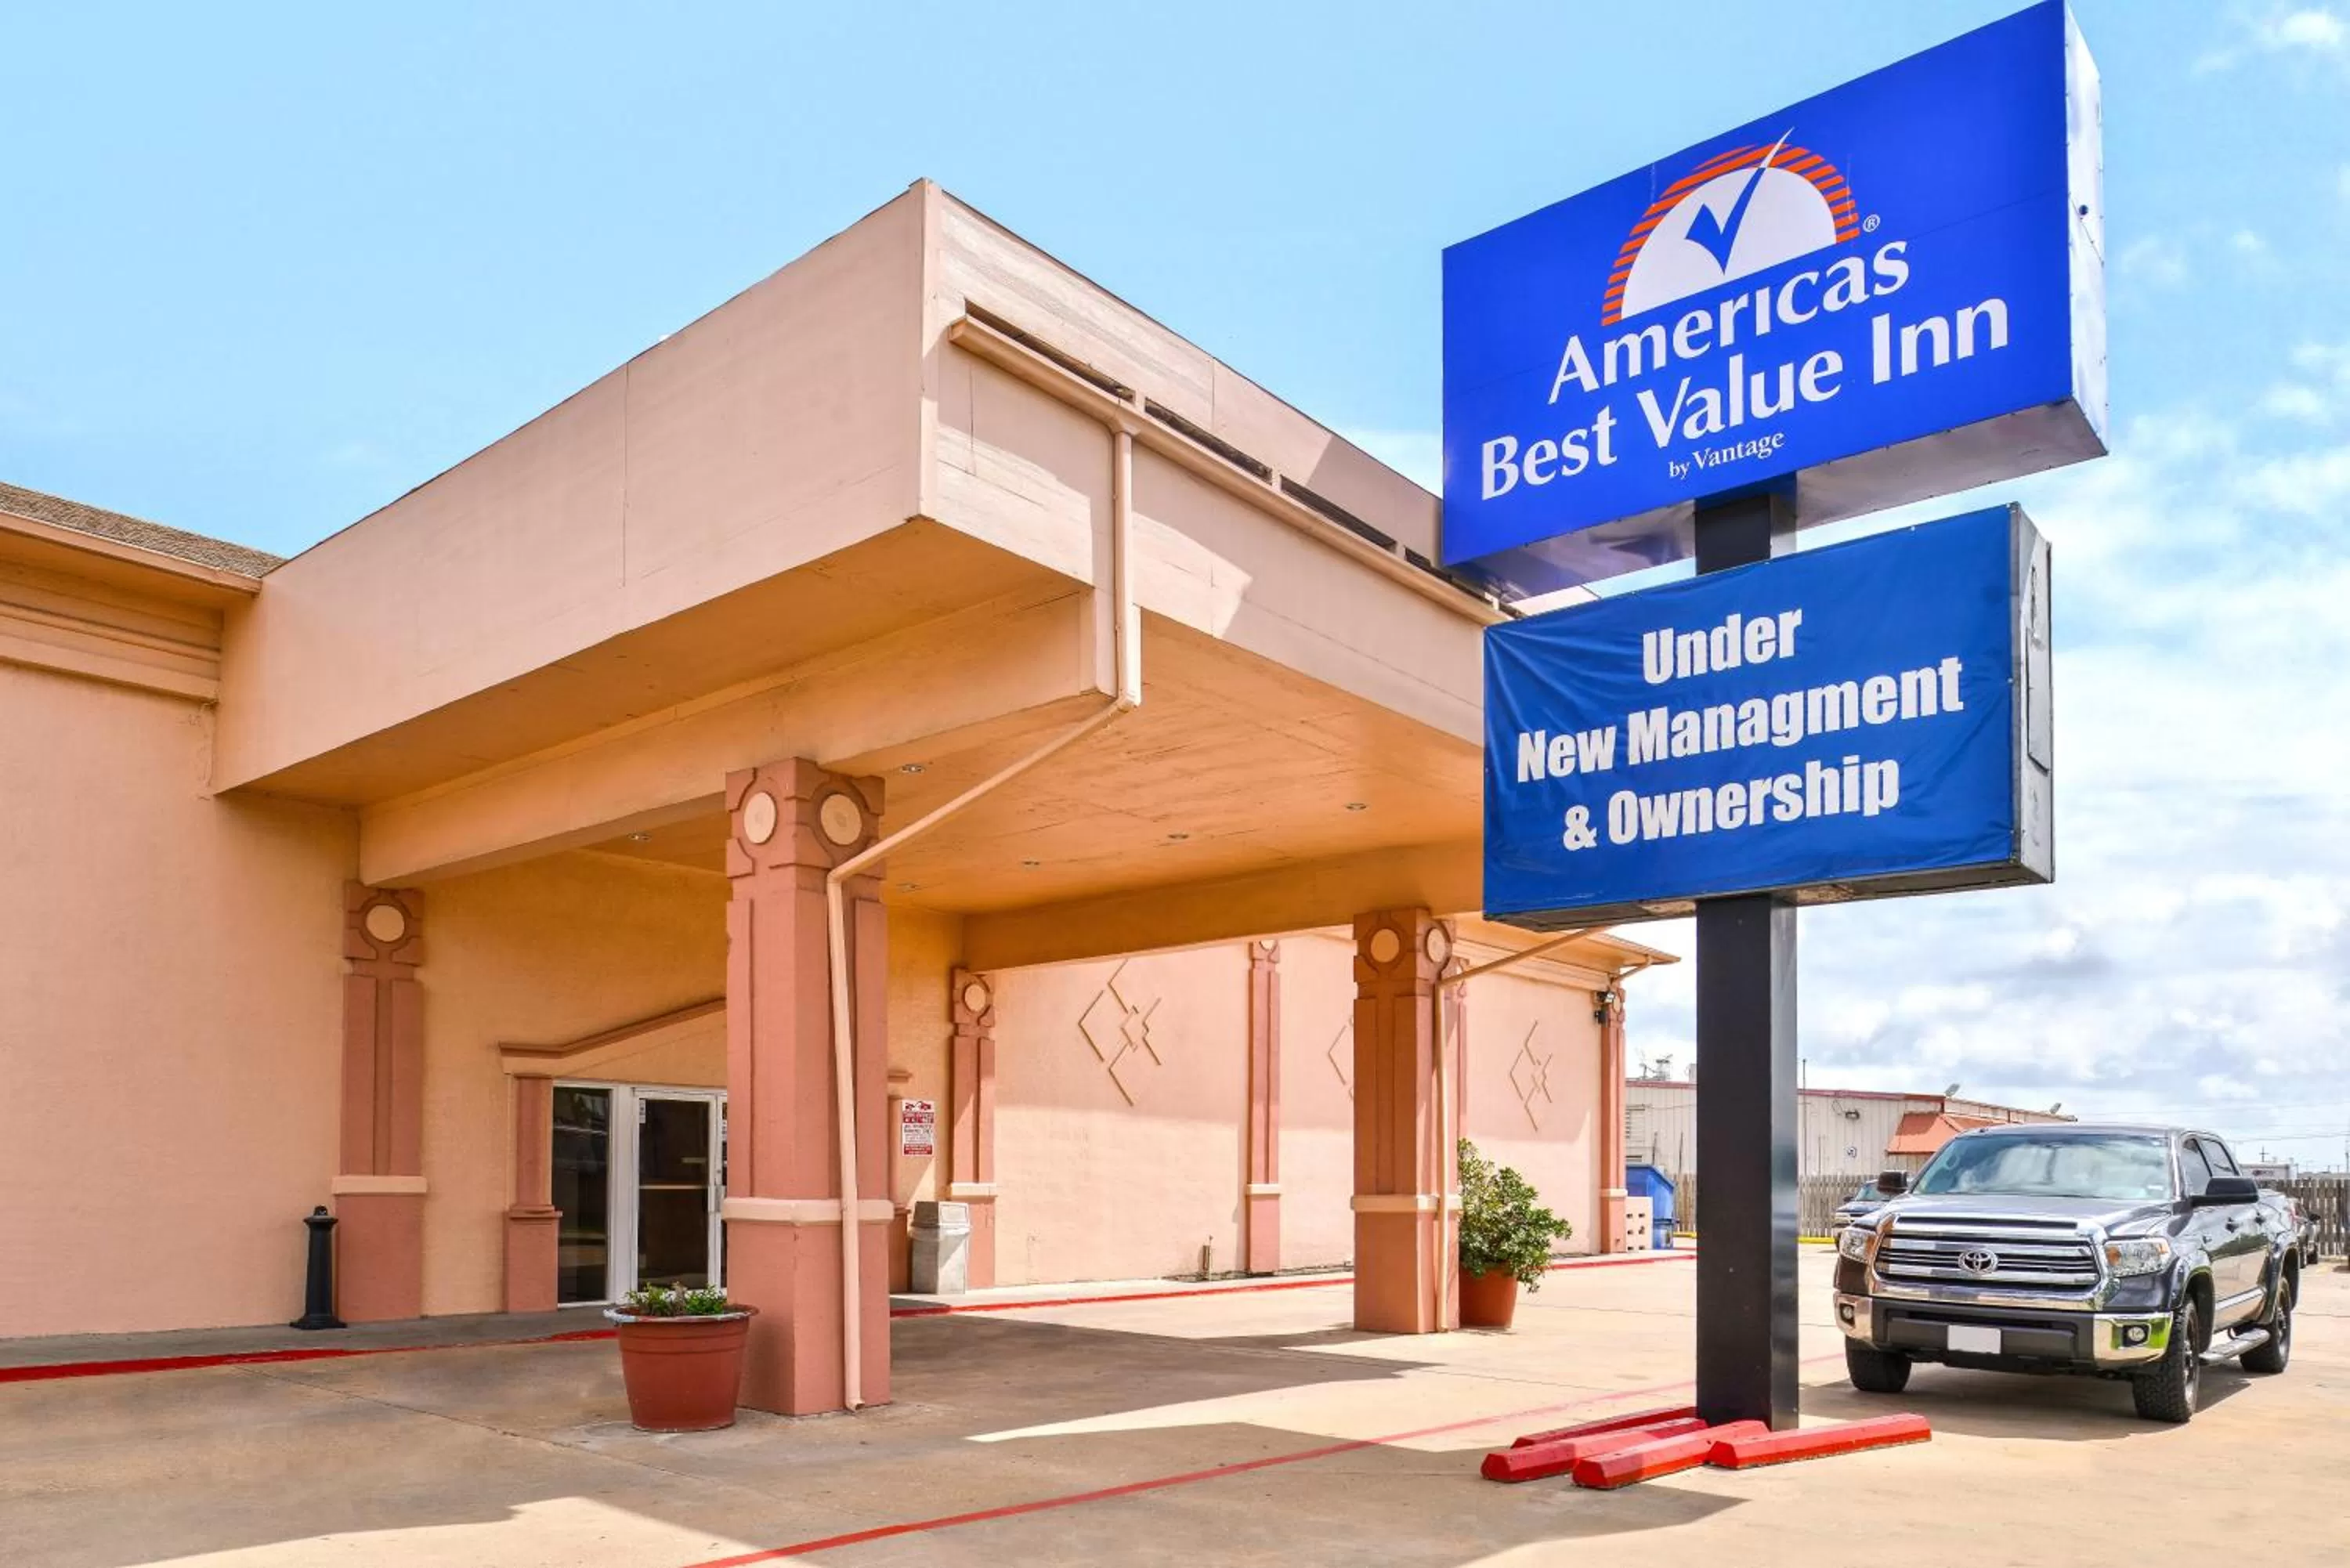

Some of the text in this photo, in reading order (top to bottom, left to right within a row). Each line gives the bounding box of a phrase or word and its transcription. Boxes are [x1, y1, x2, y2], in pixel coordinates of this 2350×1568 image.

[1548, 240, 1910, 404] Americas
[1481, 298, 2008, 501] Best Value Inn
[1668, 432, 1784, 480] by Vantage
[1643, 609, 1802, 685] Under
[1517, 656, 1964, 782] New Managment
[1563, 753, 1900, 851] & Ownership
